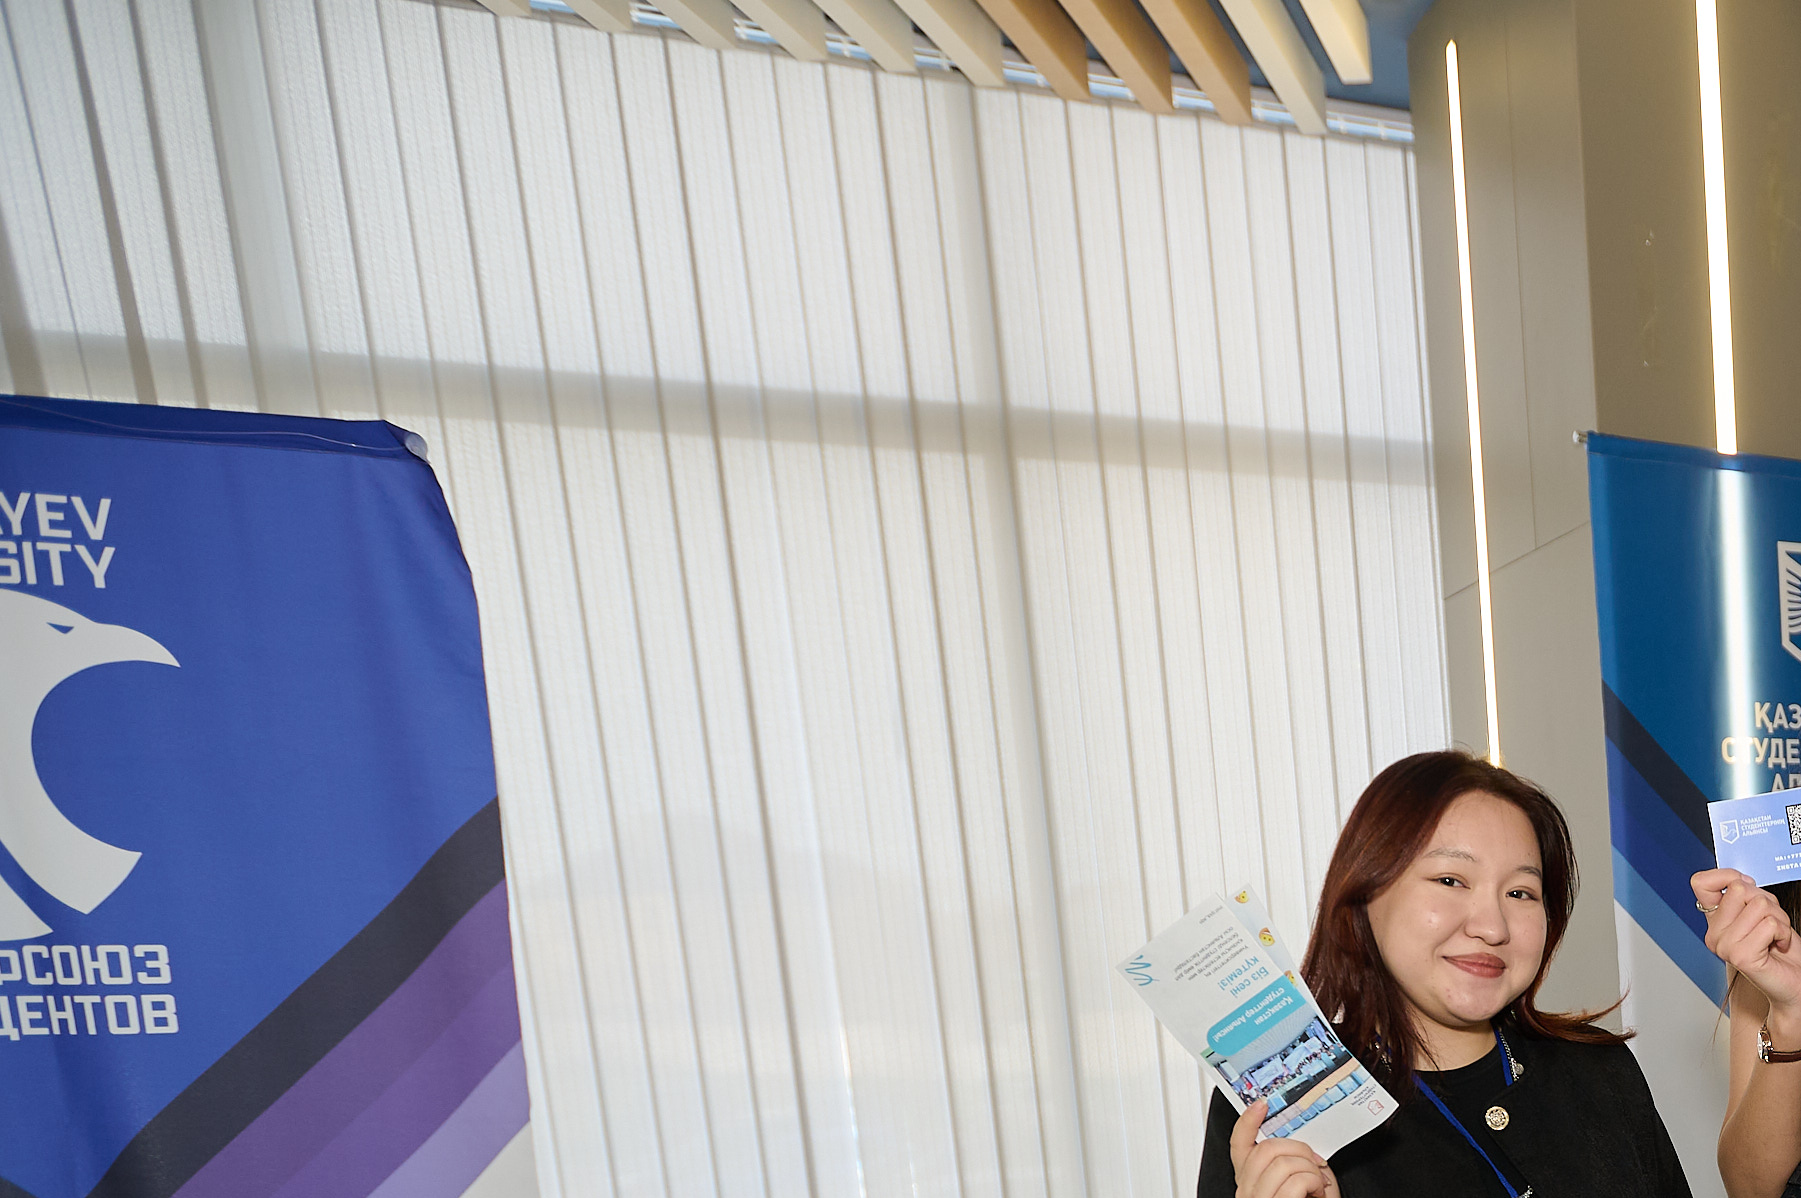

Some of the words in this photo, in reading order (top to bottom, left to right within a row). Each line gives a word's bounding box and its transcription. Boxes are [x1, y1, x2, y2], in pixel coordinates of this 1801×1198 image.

[0, 491, 111, 541] YEV
[1217, 955, 1259, 991] күтеміз!
[1251, 966, 1270, 980] Біз
[1230, 979, 1251, 998] сені
[1245, 987, 1285, 1018] студенттер
[1254, 995, 1294, 1025] Қазақстан
[1212, 1015, 1246, 1043] Альянсы!
